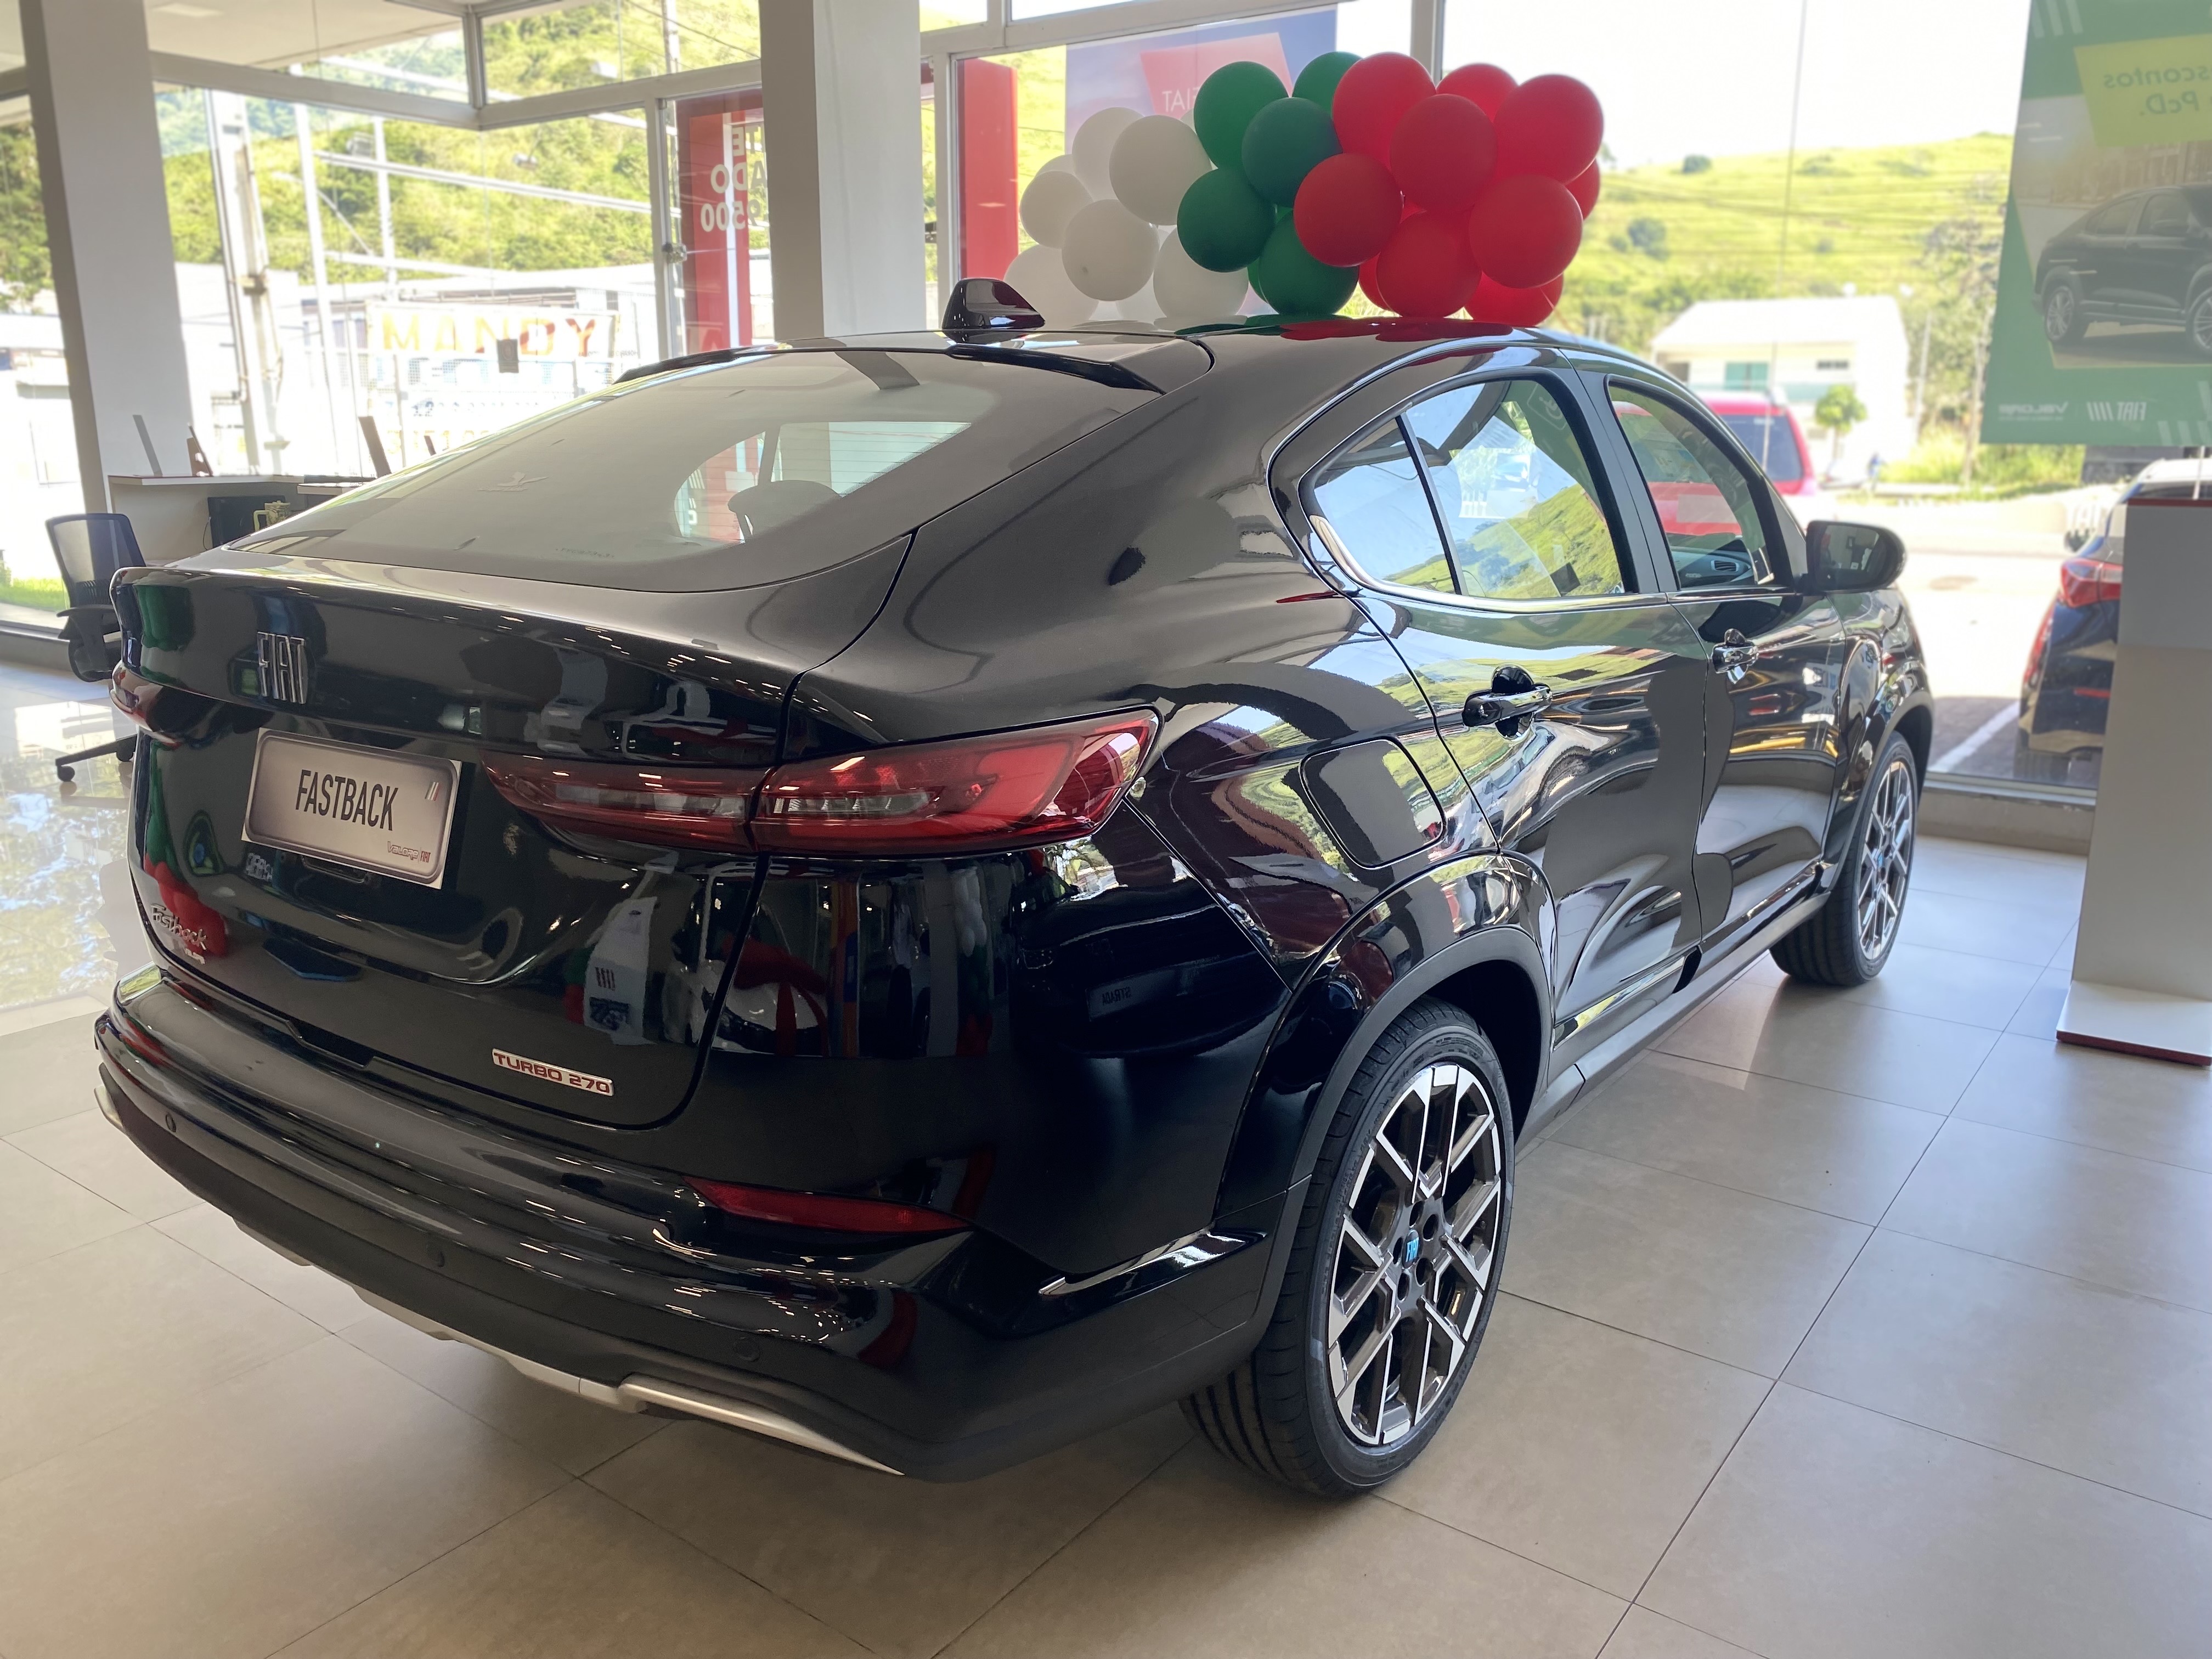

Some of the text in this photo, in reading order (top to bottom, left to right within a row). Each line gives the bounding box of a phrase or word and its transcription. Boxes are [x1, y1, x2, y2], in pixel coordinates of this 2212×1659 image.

[382, 312, 595, 357] MANDY
[257, 631, 308, 704] FIAT
[295, 769, 399, 831] FASTBACK
[420, 851, 431, 863] FIAT
[494, 1052, 610, 1093] TURBO 270
[1406, 1237, 1419, 1262] FIAT
